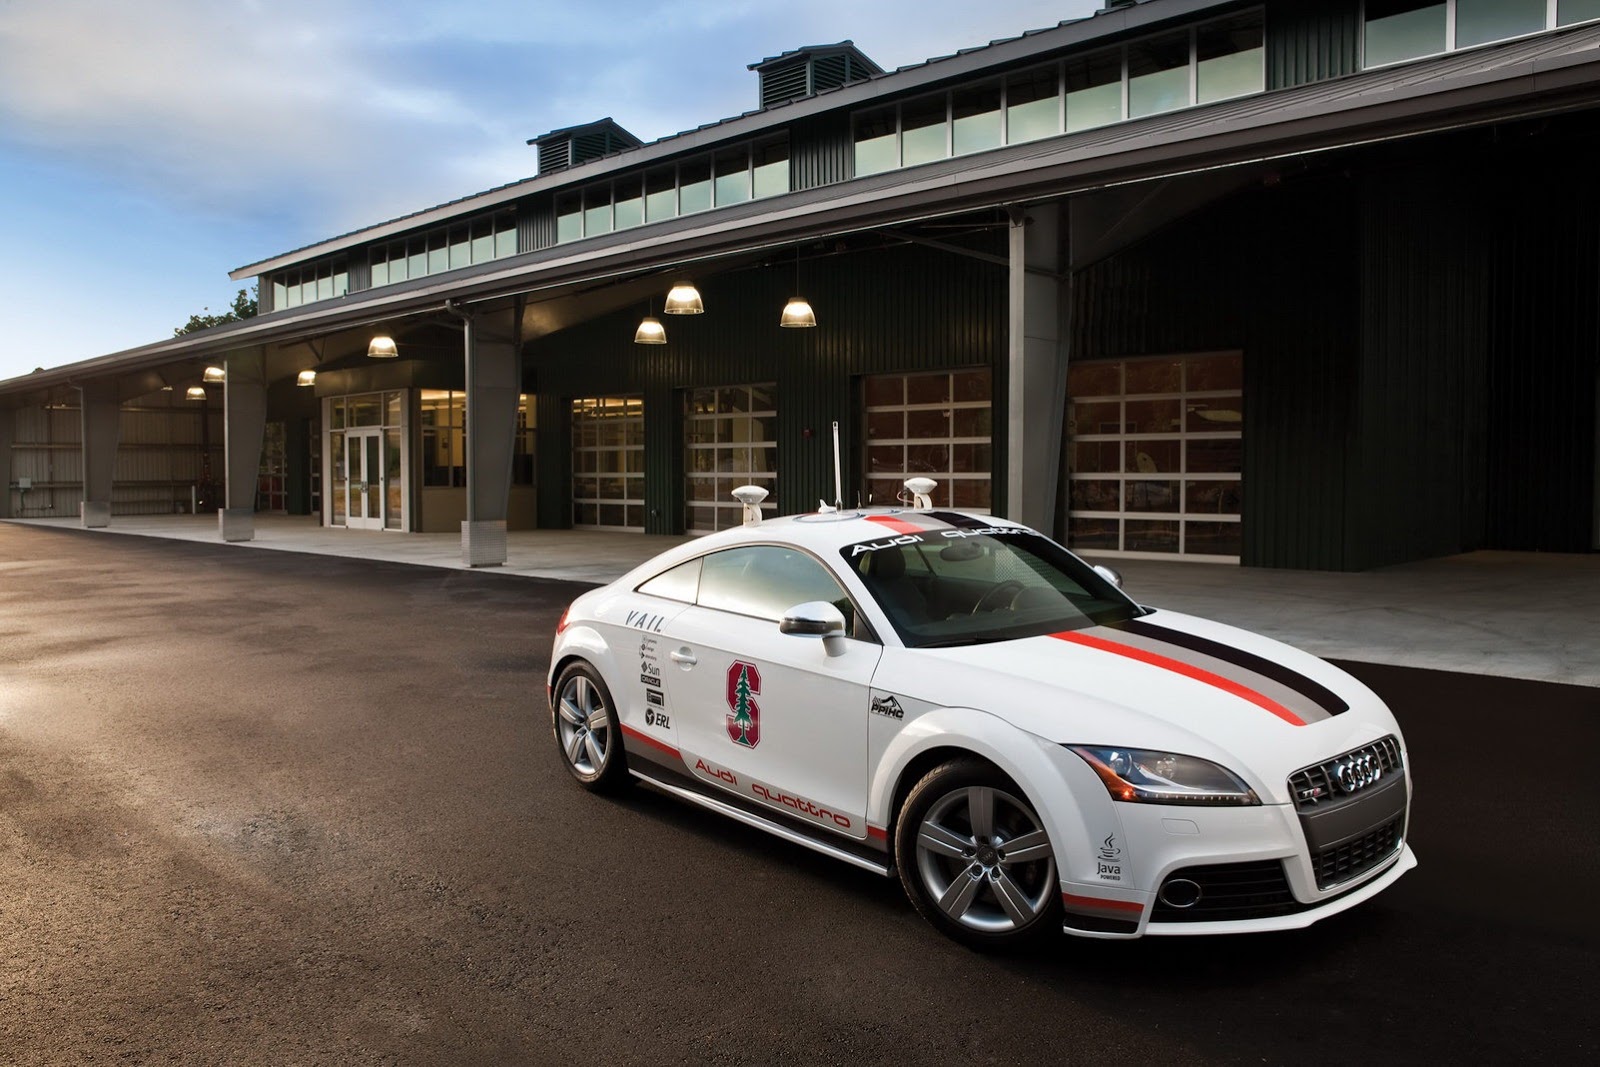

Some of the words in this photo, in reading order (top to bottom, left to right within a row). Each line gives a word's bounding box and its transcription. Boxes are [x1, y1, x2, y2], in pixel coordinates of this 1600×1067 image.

[648, 663, 660, 677] Sun
[655, 713, 671, 729] ERL
[695, 759, 737, 786] Audi
[751, 783, 850, 828] quattro
[1097, 862, 1121, 875] Java
